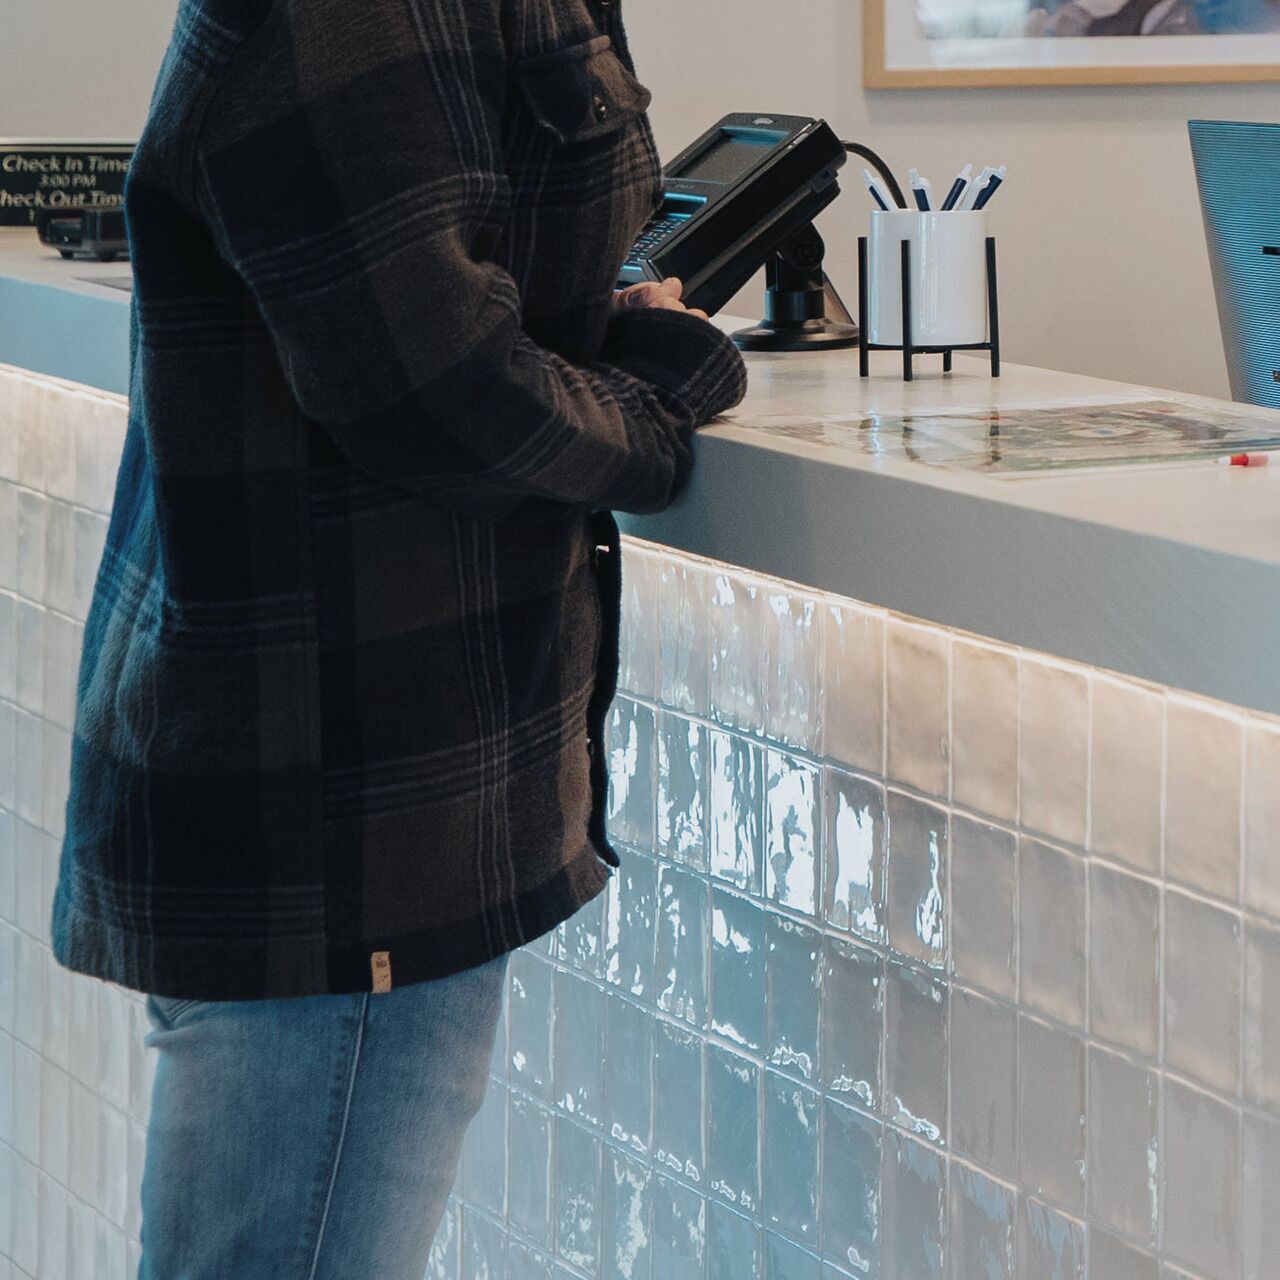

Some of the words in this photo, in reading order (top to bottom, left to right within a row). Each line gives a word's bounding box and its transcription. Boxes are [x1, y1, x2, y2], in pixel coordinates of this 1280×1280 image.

[2, 155, 60, 172] Check
[65, 156, 84, 172] In
[72, 175, 96, 187] PM
[0, 190, 45, 207] heck
[50, 190, 84, 207] Out
[90, 190, 124, 207] Tim
